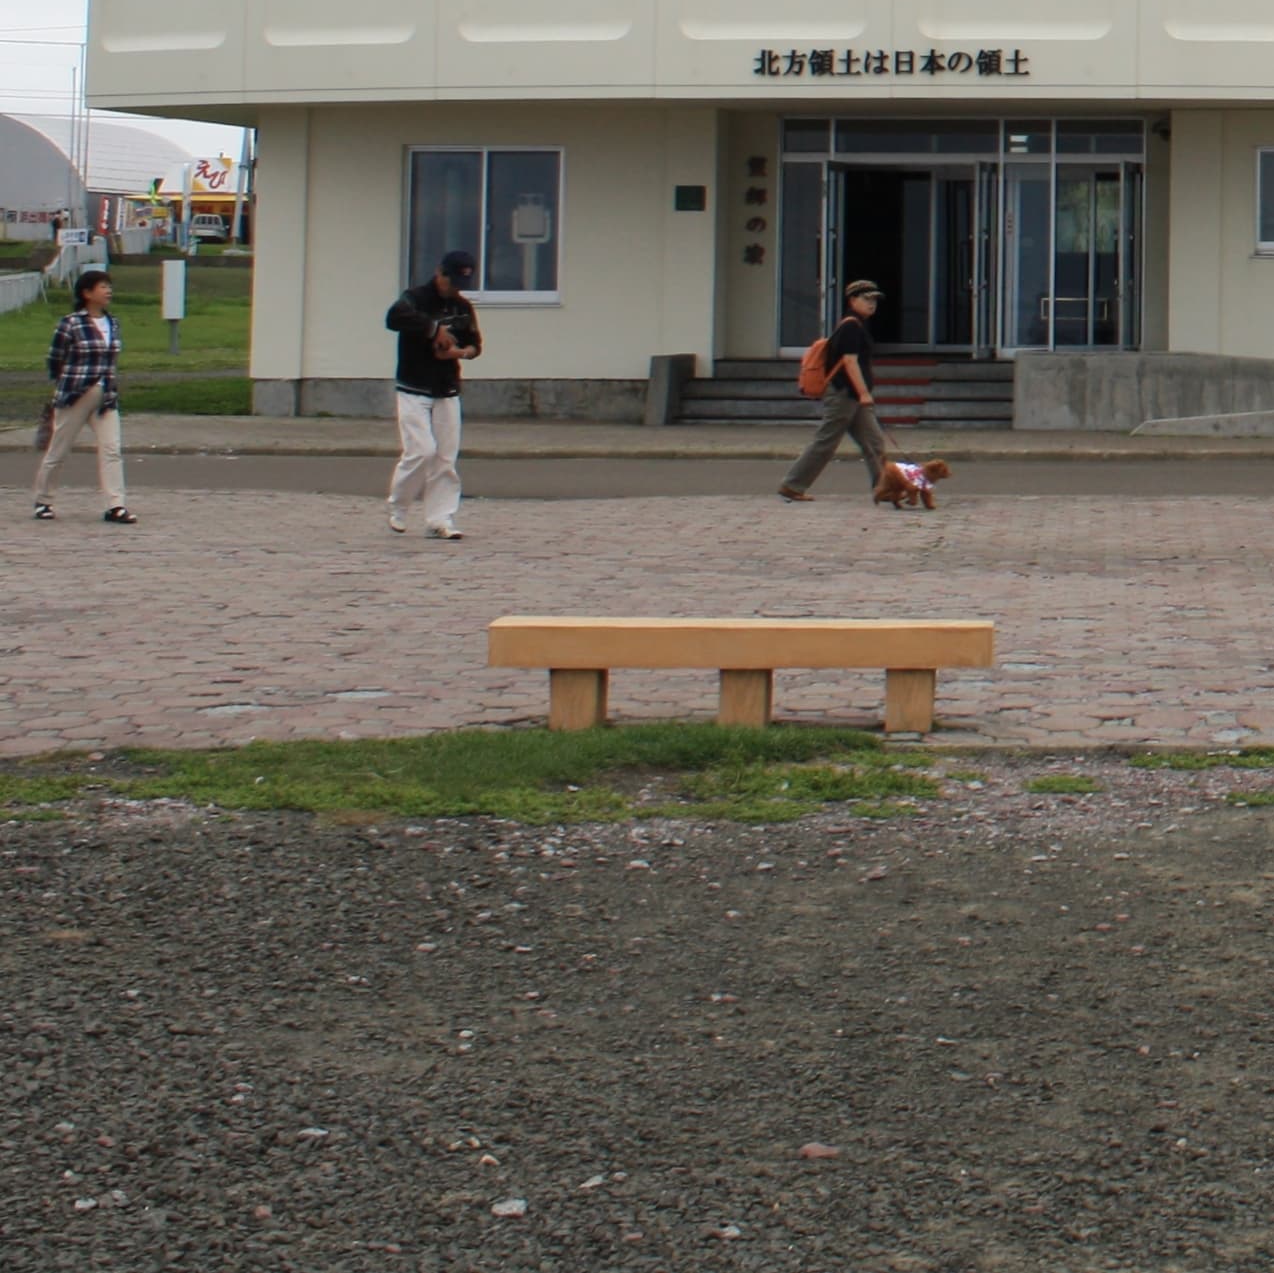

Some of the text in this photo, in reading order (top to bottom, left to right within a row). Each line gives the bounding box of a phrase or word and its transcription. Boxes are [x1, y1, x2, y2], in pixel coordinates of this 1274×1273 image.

[753, 49, 1031, 77] 北方領土は日本の領土
